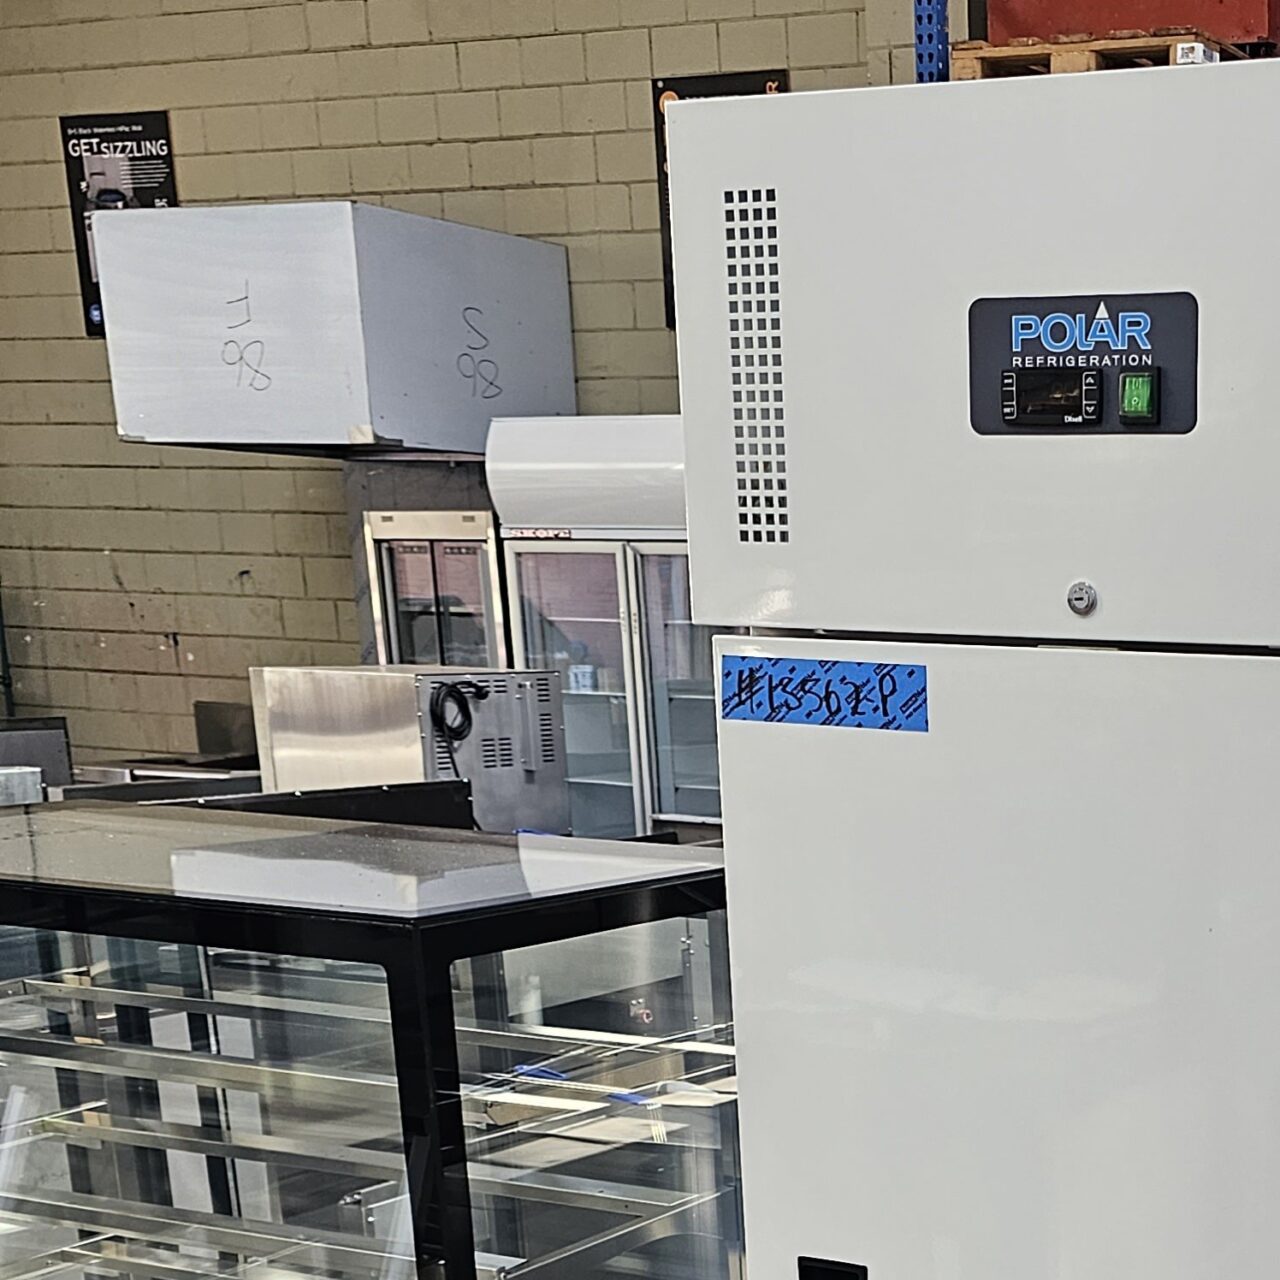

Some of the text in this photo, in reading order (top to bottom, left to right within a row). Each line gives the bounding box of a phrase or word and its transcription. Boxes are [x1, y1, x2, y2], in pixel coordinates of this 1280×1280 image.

[68, 138, 168, 158] GET SIZZLING
[1011, 300, 1152, 353] POLAR
[1012, 354, 1152, 368] REFRIGERATION
